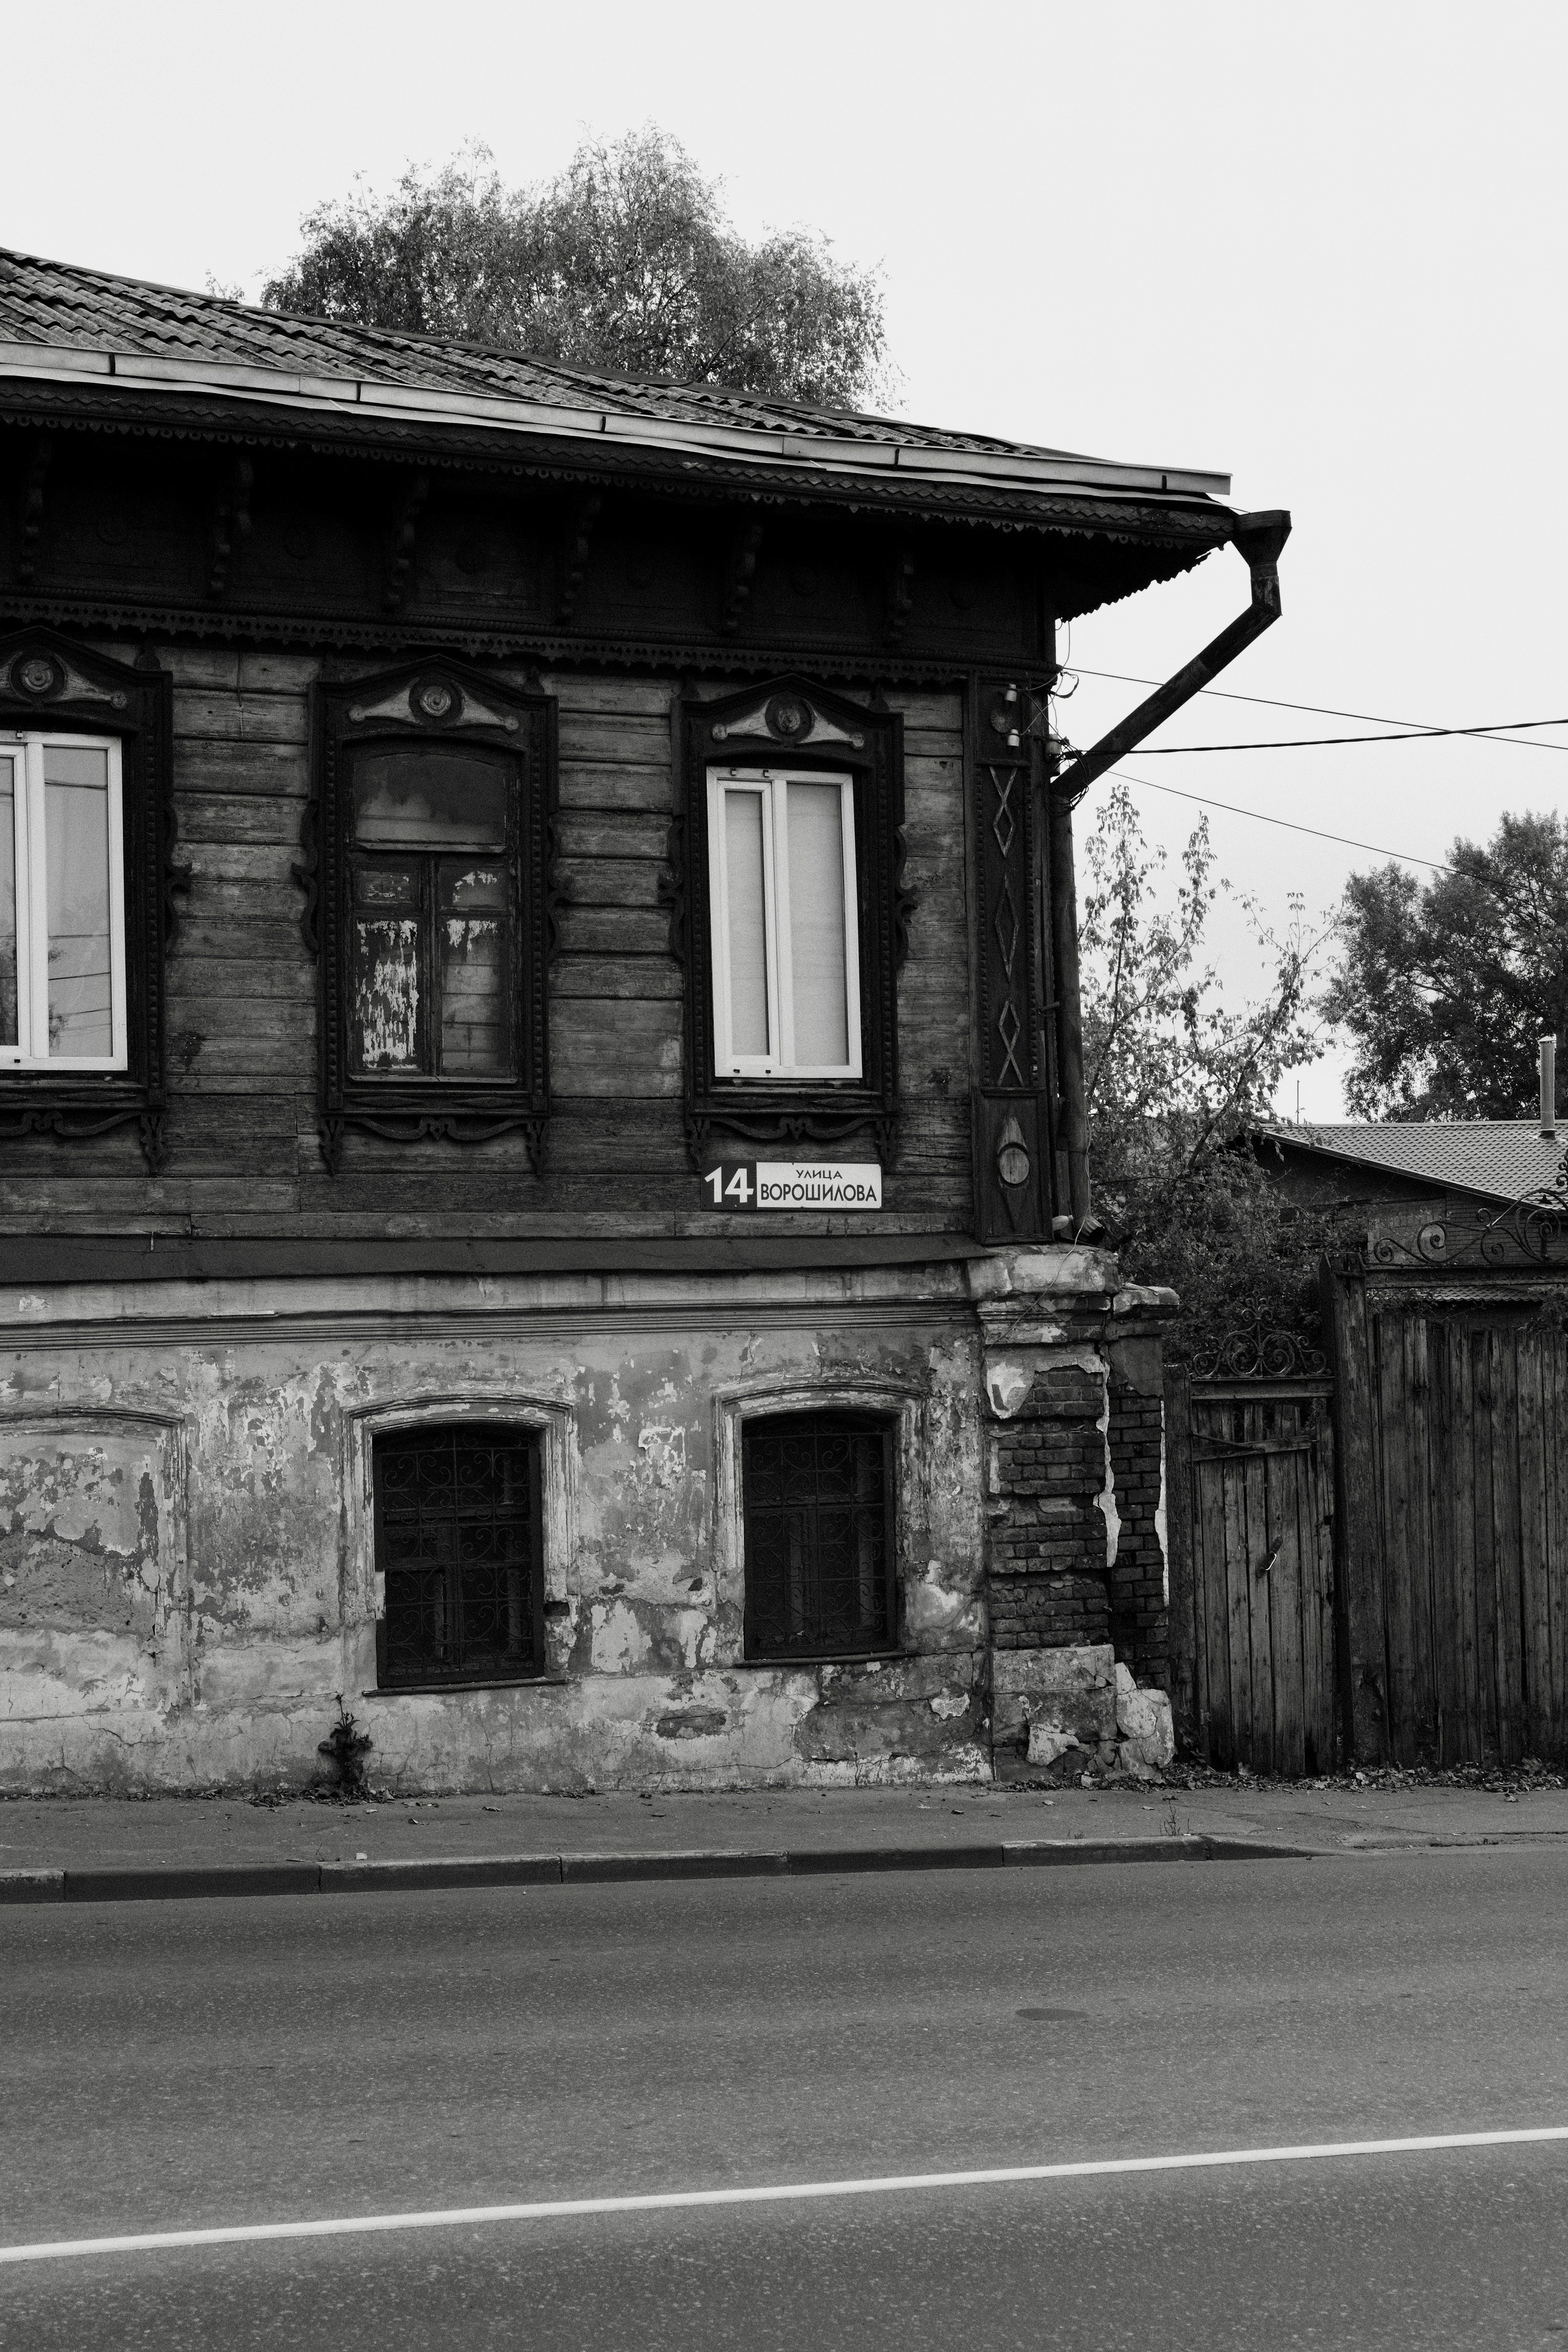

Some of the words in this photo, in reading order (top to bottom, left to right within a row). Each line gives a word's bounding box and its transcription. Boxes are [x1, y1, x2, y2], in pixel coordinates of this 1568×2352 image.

[796, 1169, 843, 1180] УЛИЦА
[704, 1166, 754, 1203] 14
[761, 1183, 877, 1202] ВОРОШИЛОВА
